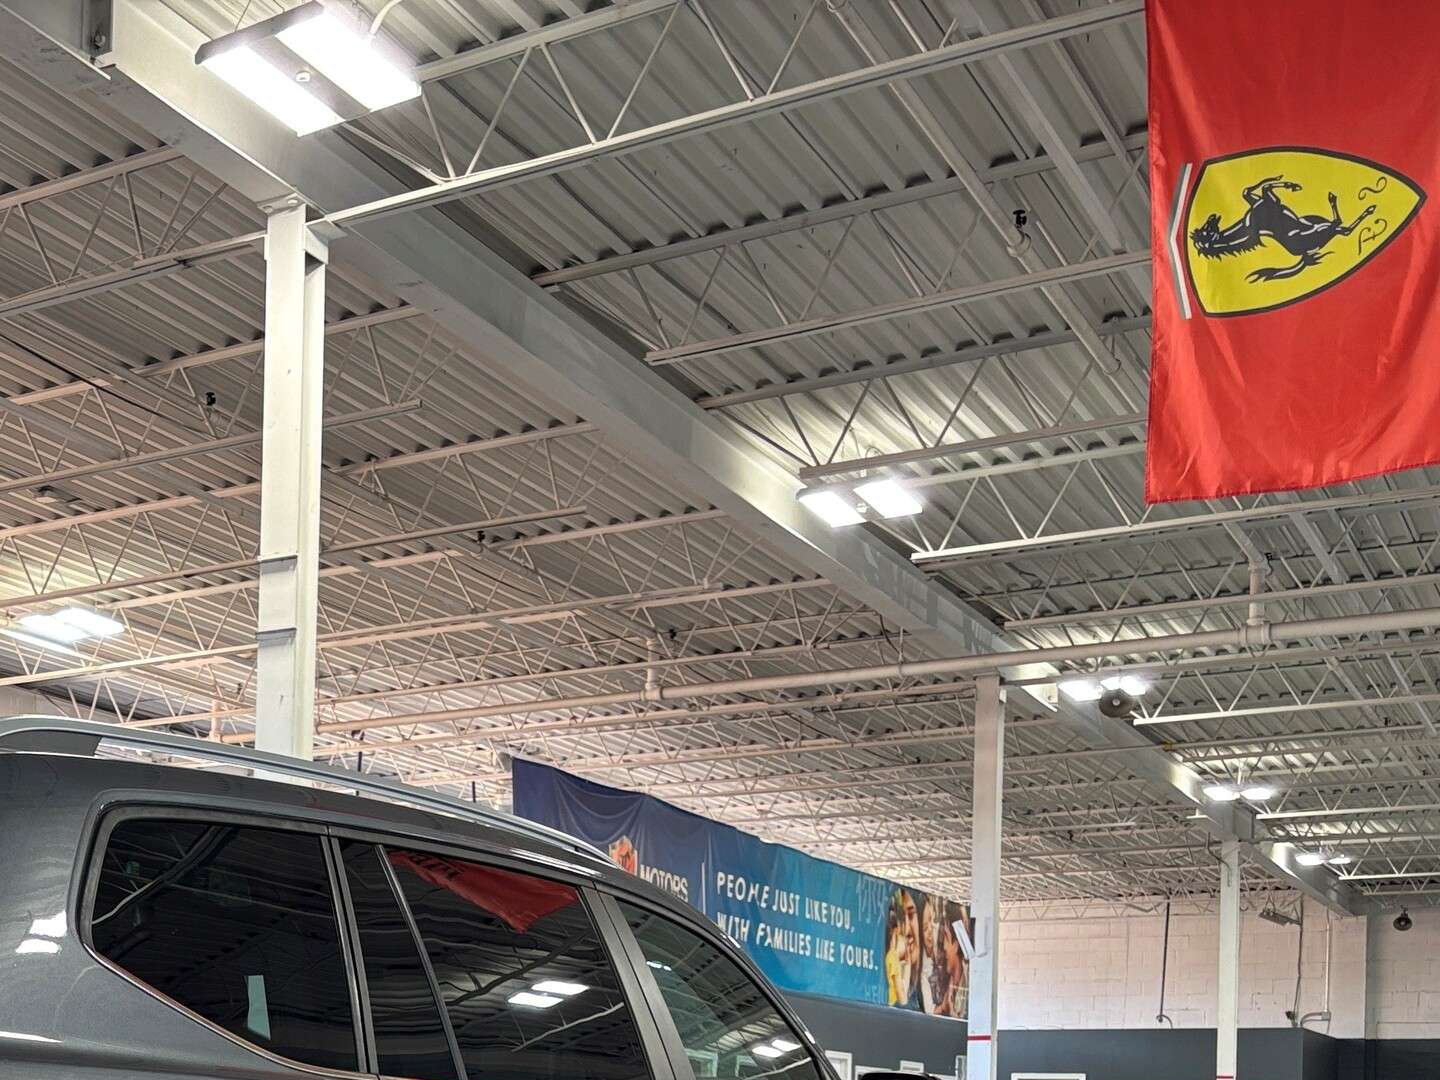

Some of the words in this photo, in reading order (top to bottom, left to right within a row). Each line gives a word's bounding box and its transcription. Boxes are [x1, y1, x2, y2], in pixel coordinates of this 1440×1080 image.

[772, 888, 800, 917] JUST
[805, 897, 828, 924] LIKE
[830, 907, 855, 934] YOU,
[717, 911, 750, 944] WITH
[755, 922, 811, 957] FAMILIES
[815, 937, 835, 963] LIKE
[839, 943, 879, 972] YOURS.
